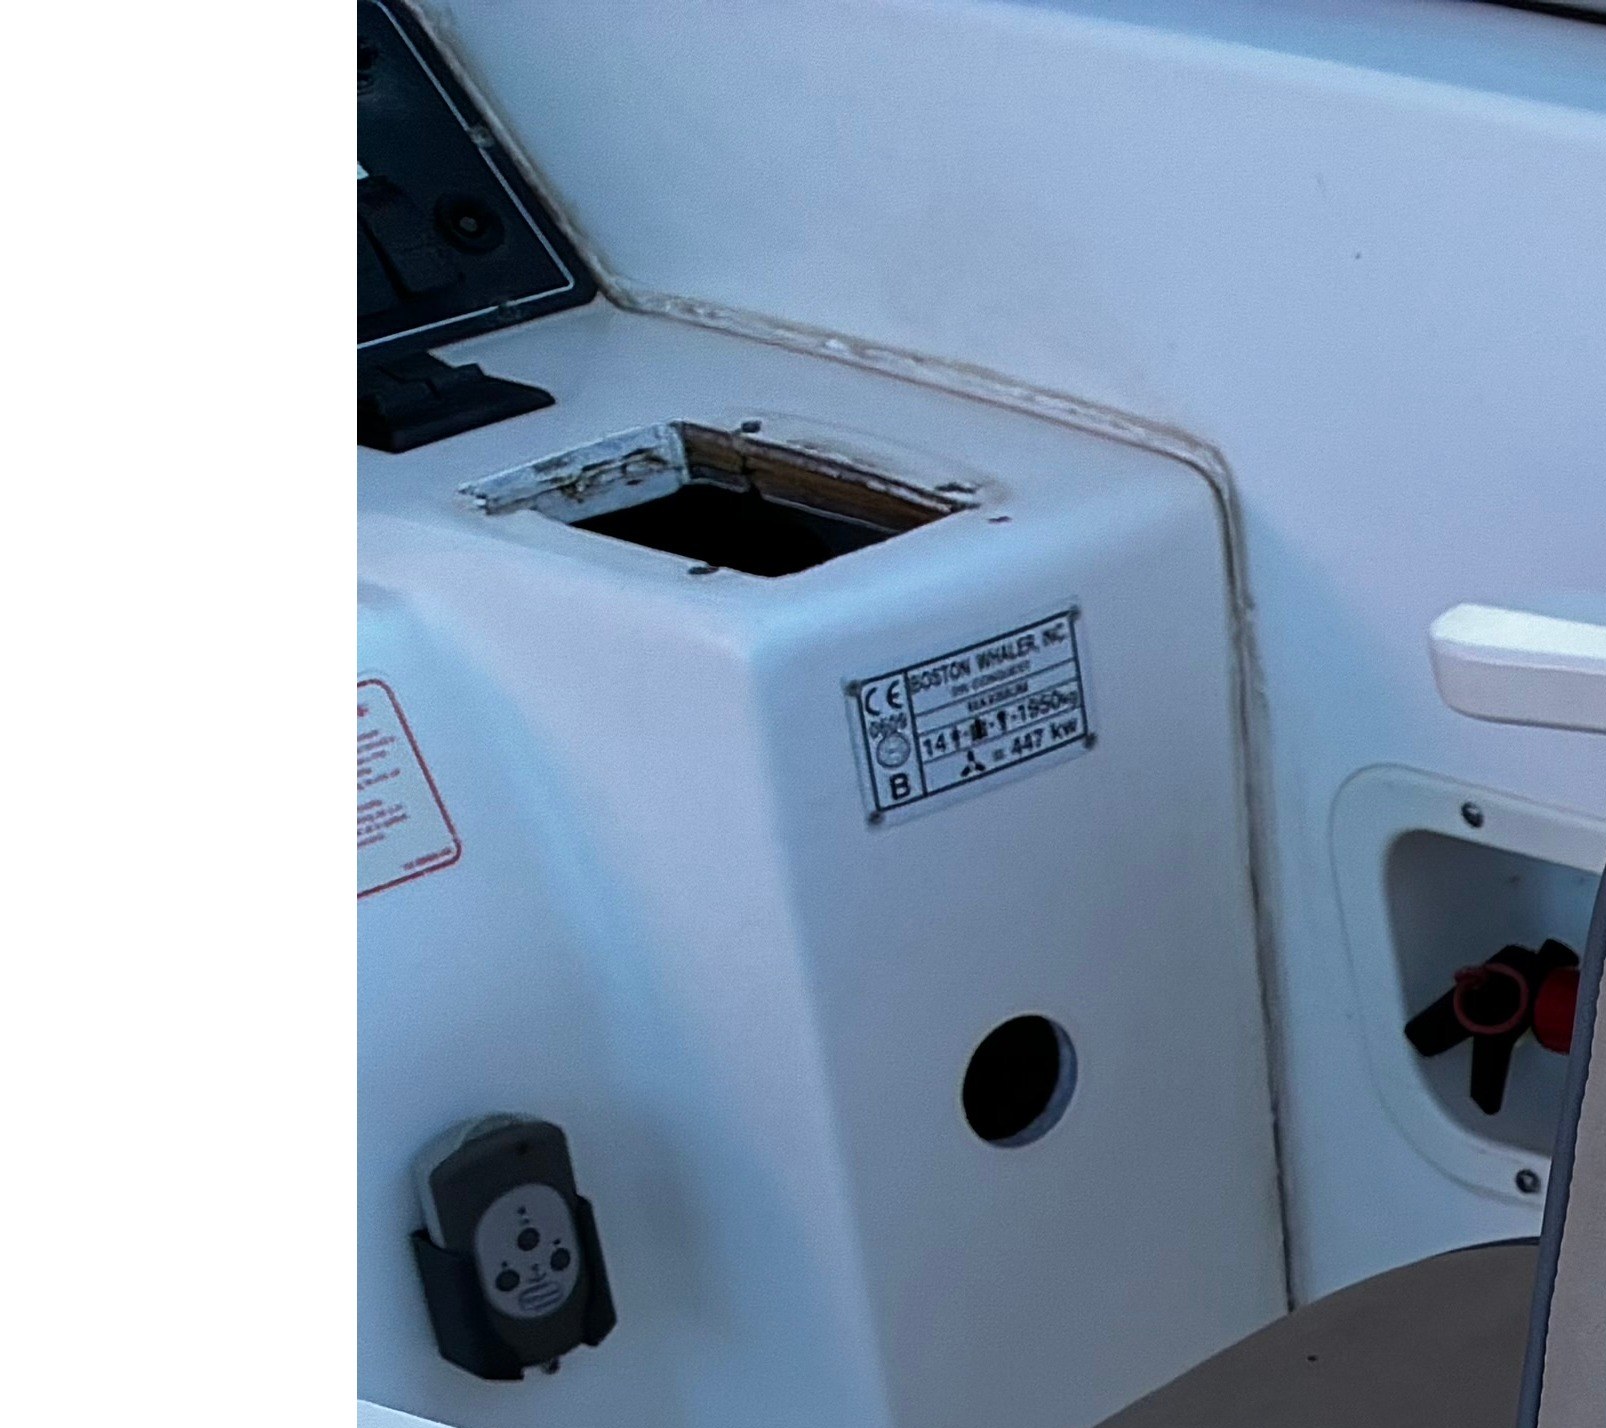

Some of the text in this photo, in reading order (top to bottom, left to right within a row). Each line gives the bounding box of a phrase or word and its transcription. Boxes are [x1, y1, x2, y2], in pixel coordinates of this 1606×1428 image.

[909, 658, 970, 694] BOSTON
[1011, 728, 1045, 755] 447
[889, 772, 911, 800] B
